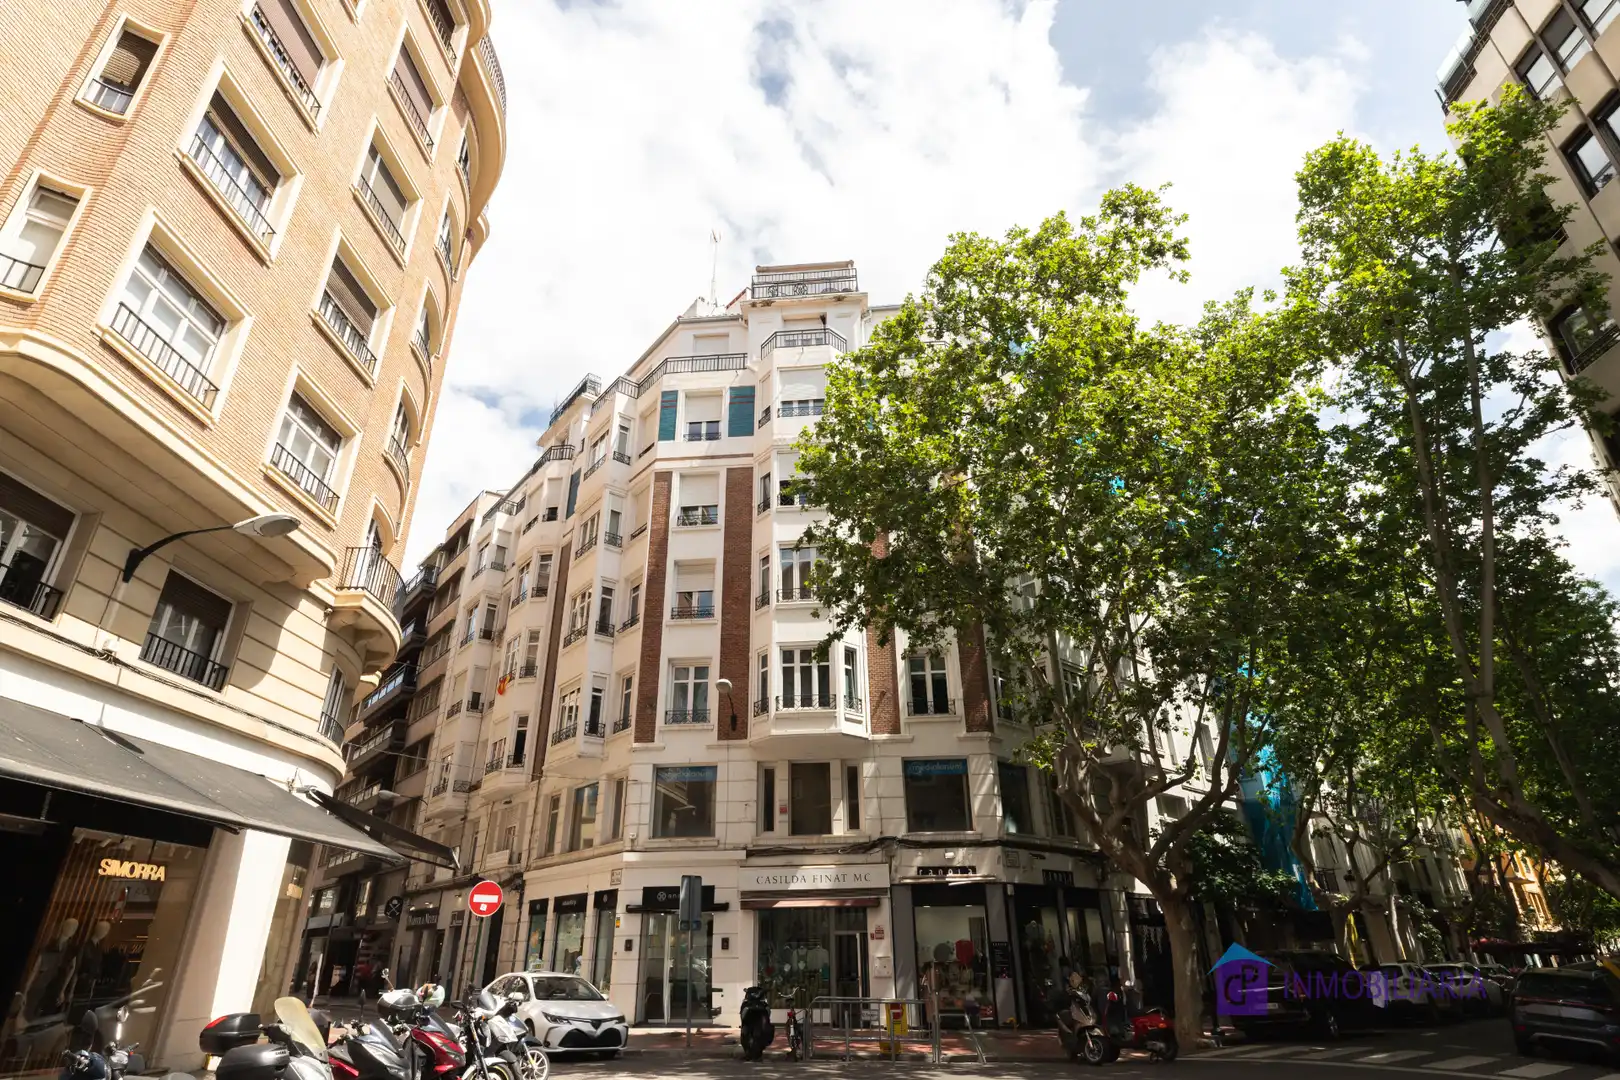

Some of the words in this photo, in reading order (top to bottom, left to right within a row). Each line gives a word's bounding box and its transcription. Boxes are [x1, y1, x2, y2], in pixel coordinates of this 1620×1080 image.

[98, 858, 166, 881] SIMORRA
[756, 875, 807, 885] CASILDA
[812, 873, 848, 883] FINAT
[853, 873, 871, 882] MC
